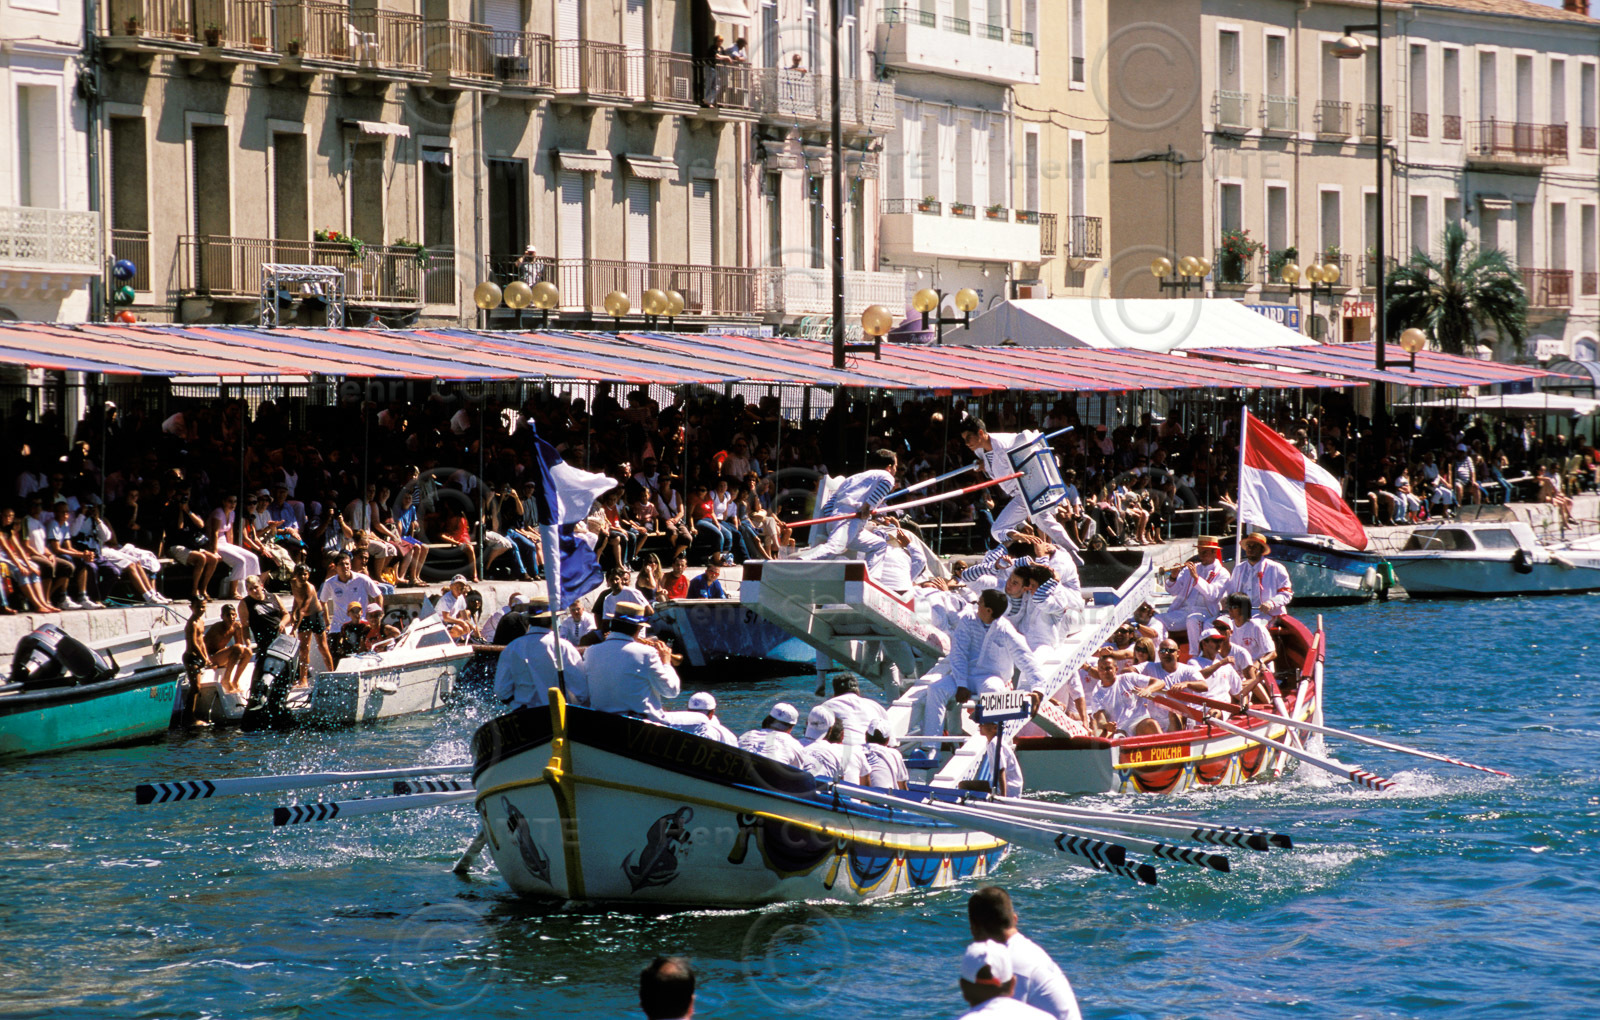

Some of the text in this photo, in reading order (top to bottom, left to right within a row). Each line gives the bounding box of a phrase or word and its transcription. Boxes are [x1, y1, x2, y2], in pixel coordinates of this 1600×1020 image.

[981, 694, 1024, 711] CUCINIELLO
[627, 722, 692, 762] VILLE
[691, 743, 721, 770] DE
[717, 752, 758, 780] SETE
[1130, 746, 1182, 763] LA PONCHA
